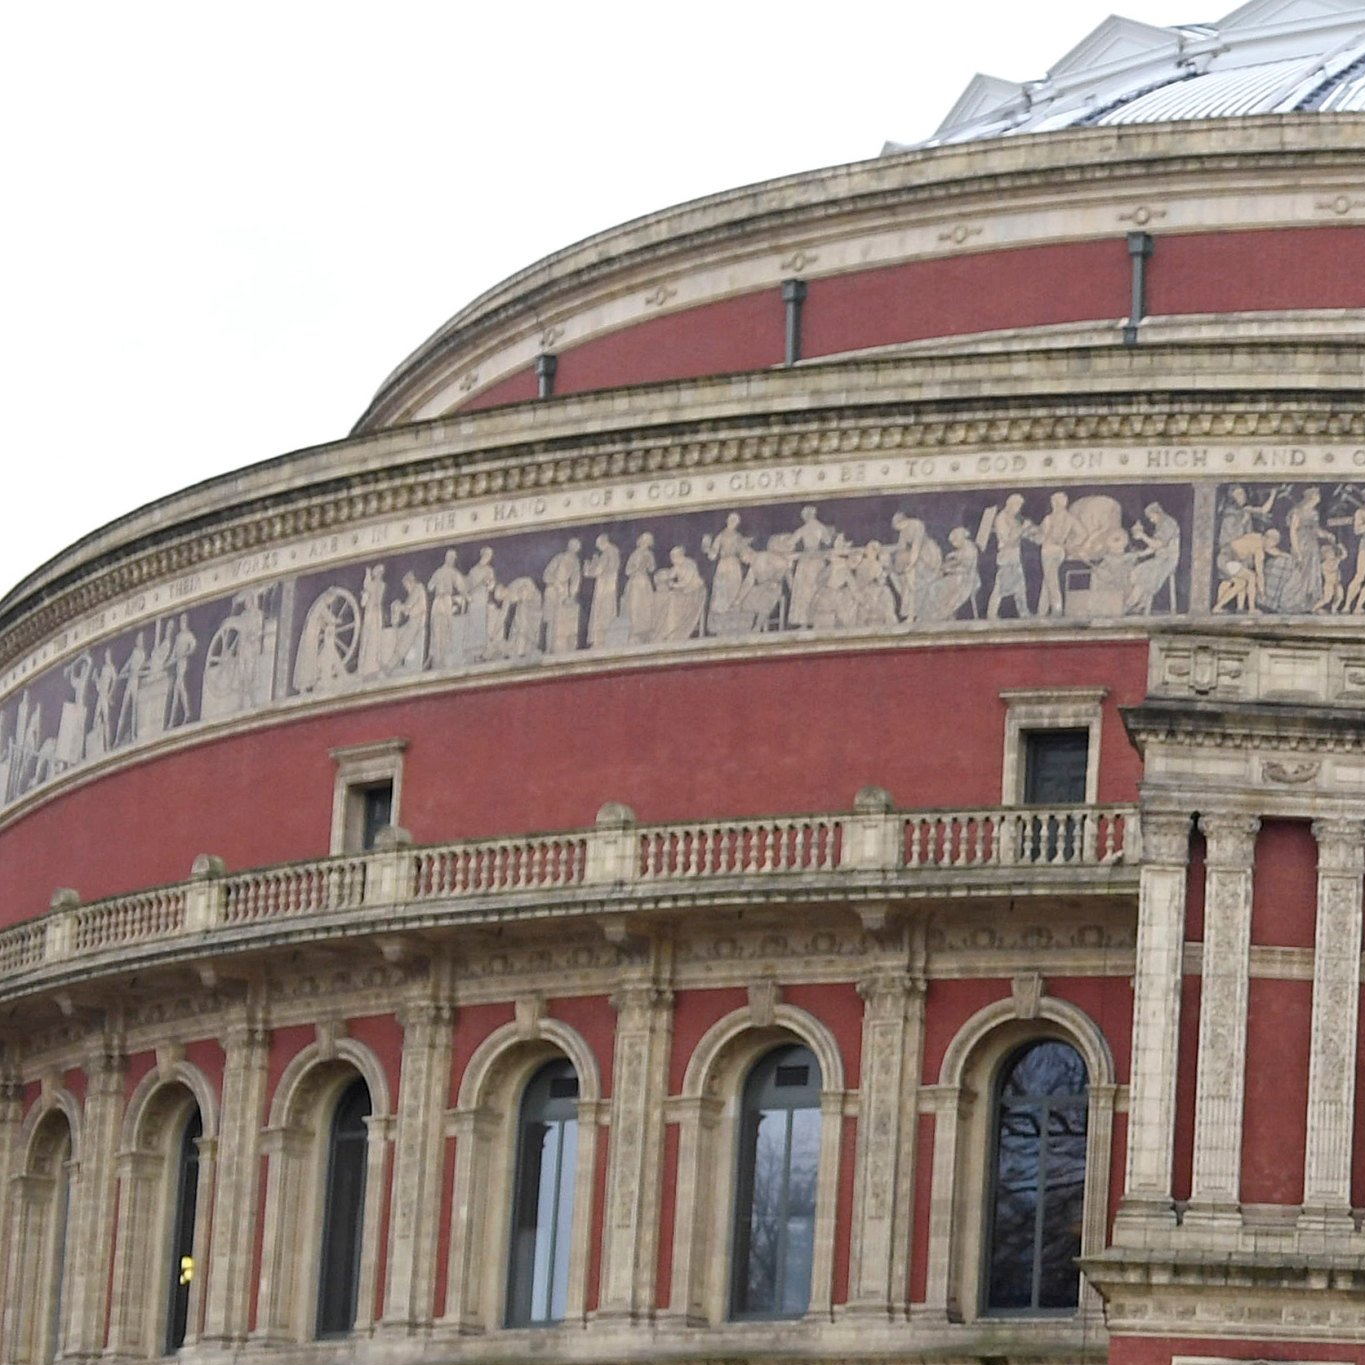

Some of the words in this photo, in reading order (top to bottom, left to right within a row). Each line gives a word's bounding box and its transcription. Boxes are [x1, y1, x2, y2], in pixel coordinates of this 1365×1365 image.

[371, 525, 389, 544] IN
[423, 511, 456, 533] THE
[493, 498, 546, 522] HAND
[647, 481, 692, 500] GOD
[729, 468, 802, 492] GLORY
[840, 465, 867, 483] BE
[905, 459, 936, 478] TO
[976, 454, 1028, 474] GOD
[1069, 452, 1103, 470] ON
[1146, 449, 1209, 468] HIGH
[1253, 449, 1307, 466] AND
